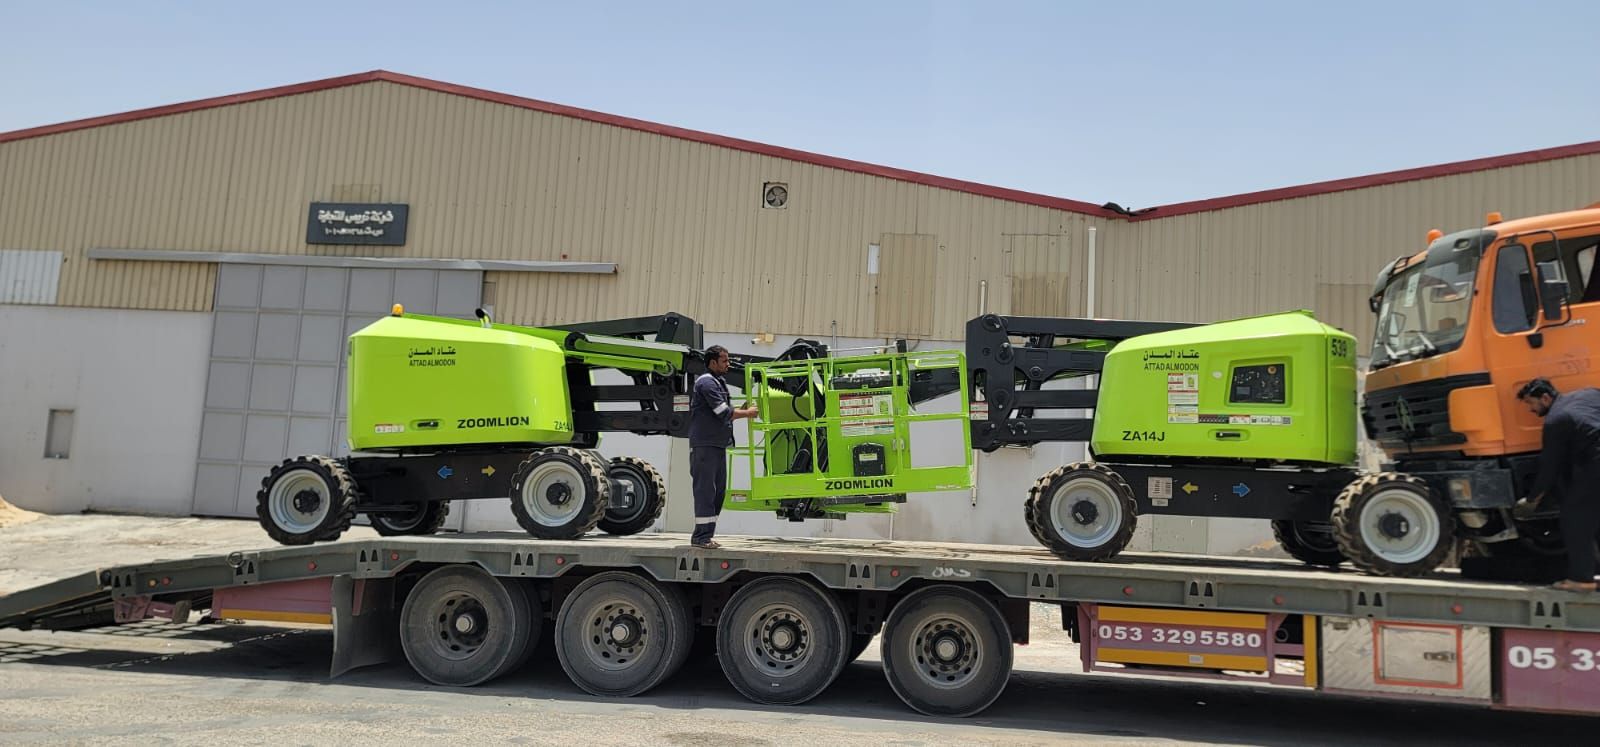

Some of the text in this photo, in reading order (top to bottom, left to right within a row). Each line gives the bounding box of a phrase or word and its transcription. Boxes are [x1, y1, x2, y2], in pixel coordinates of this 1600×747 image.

[1143, 349, 1200, 361] عتاد المدن
[1144, 362, 1200, 371] ATTAD ALMODON
[457, 416, 530, 429] ZOOMLION
[1122, 430, 1165, 442] ZA14J
[825, 478, 893, 491] ZOOMLION
[1098, 625, 1262, 647] 053 3295580
[1508, 645, 1600, 672] 05 3
